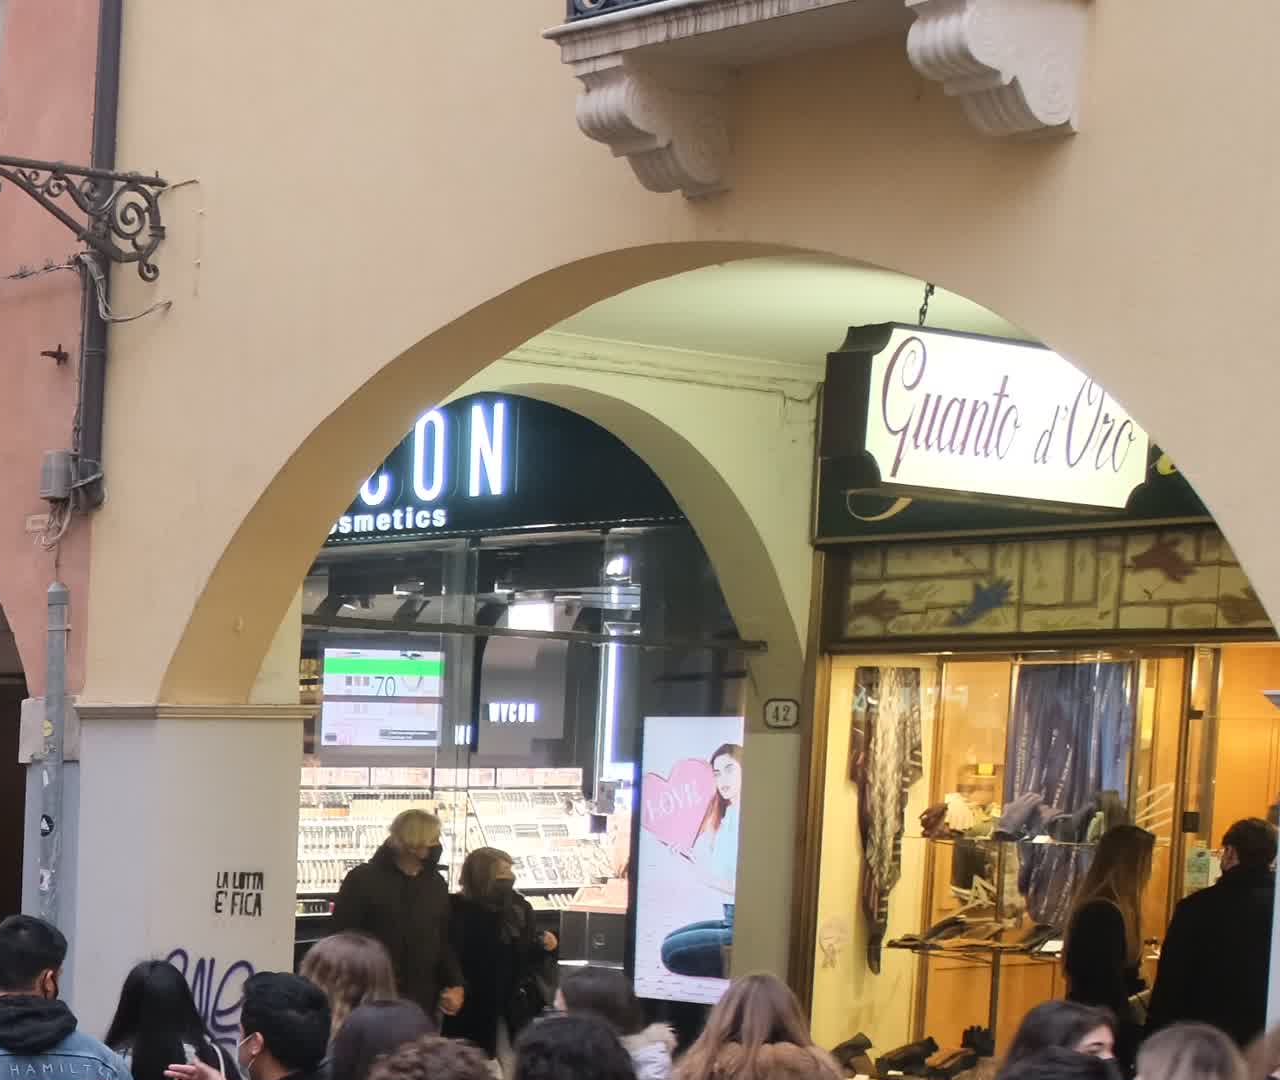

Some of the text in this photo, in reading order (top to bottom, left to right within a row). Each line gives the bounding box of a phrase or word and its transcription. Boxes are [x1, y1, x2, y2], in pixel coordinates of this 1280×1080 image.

[882, 336, 1022, 478] Guanto
[772, 704, 791, 723] 42
[216, 871, 264, 891] LA LOTTA
[231, 892, 262, 917] FICA
